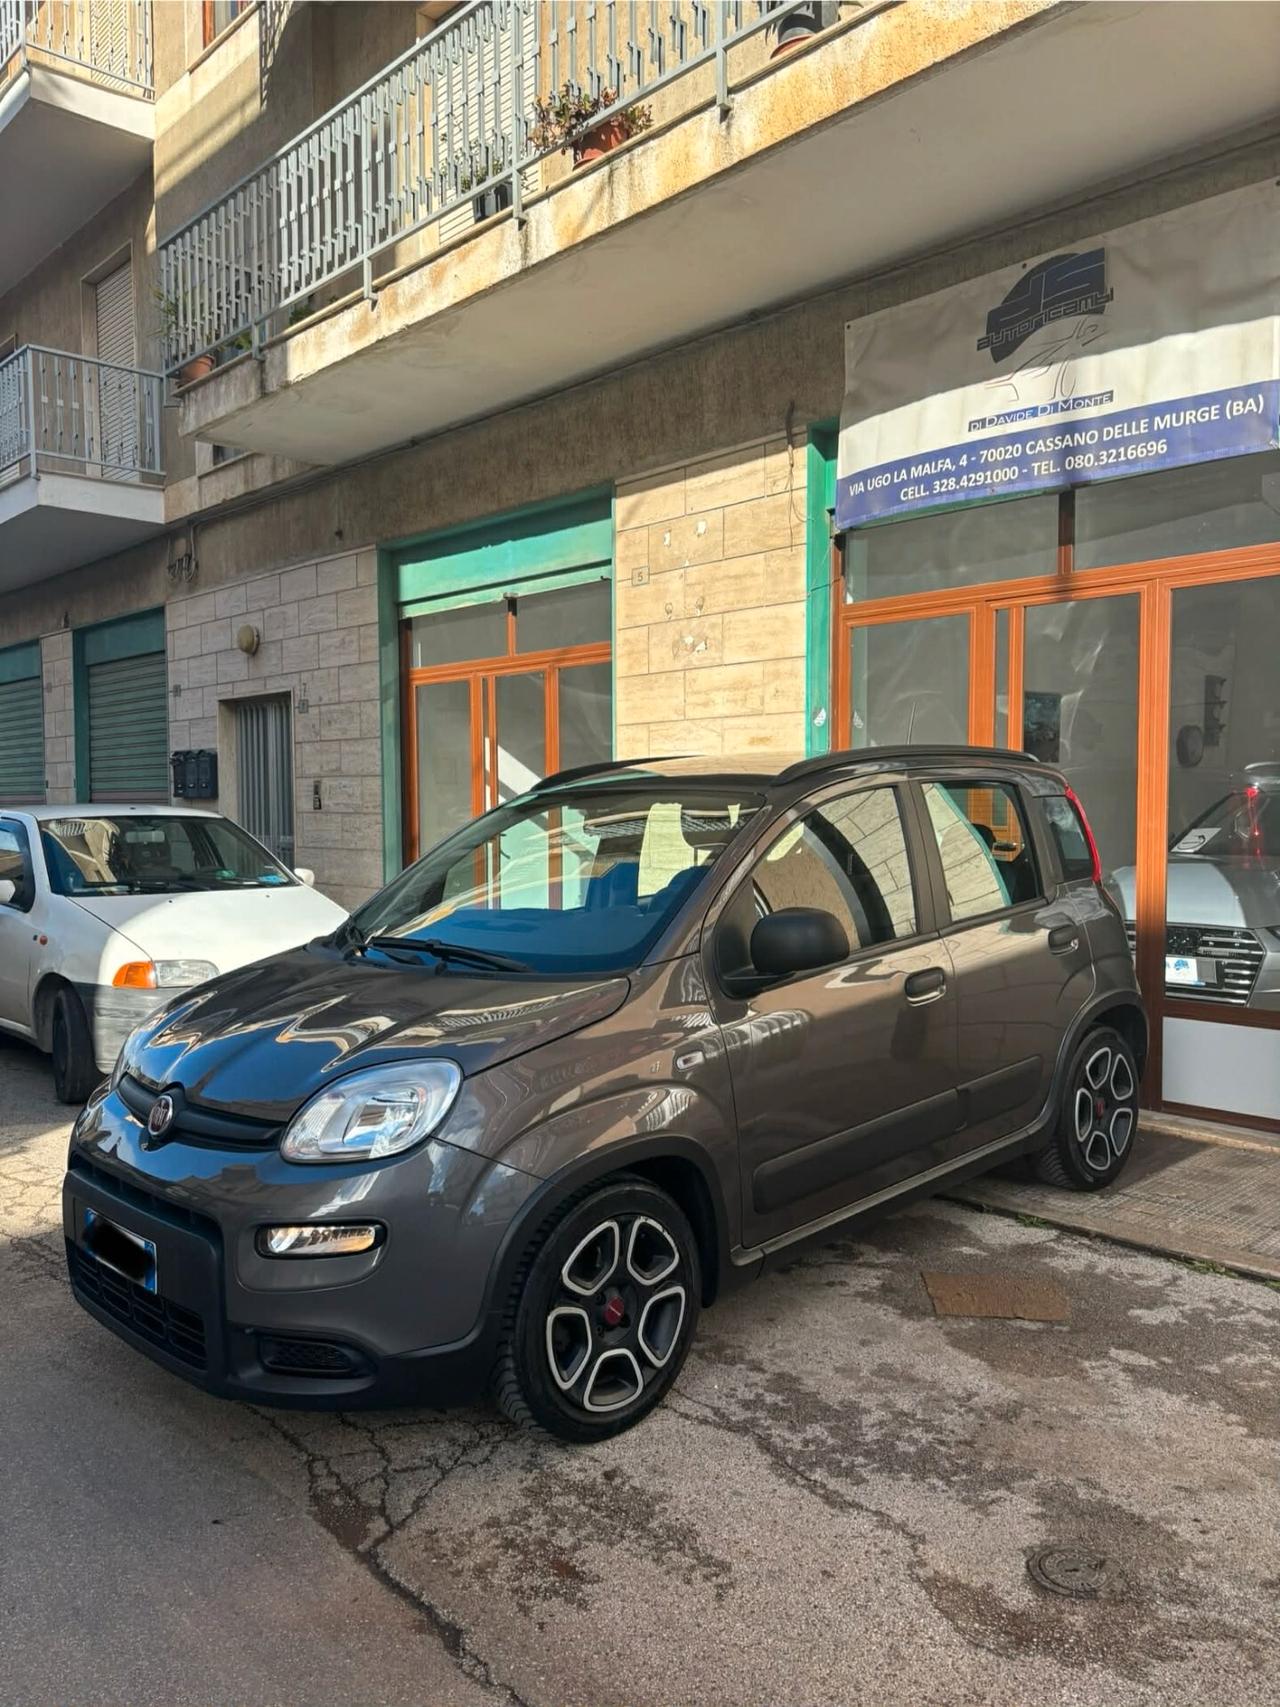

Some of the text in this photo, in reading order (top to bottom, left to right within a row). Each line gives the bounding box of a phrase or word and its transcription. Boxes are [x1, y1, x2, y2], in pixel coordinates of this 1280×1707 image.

[985, 408, 1034, 427] DAVIDE
[1057, 392, 1112, 413] MONTE
[849, 482, 865, 497] VIA
[867, 473, 891, 491] UGO
[894, 467, 908, 483] LA
[910, 457, 956, 479] MALFA,
[959, 454, 968, 467] 4
[979, 443, 1022, 464] 70020
[1025, 429, 1099, 456] CASSANO
[1102, 418, 1150, 441] DELLE
[1153, 403, 1221, 431] MURGE
[1225, 394, 1264, 420] (BA)
[900, 484, 930, 501] CELL.
[933, 465, 1019, 494] 328.4291000
[1032, 459, 1061, 477] TEL.
[1065, 438, 1168, 471] 080.3216696
